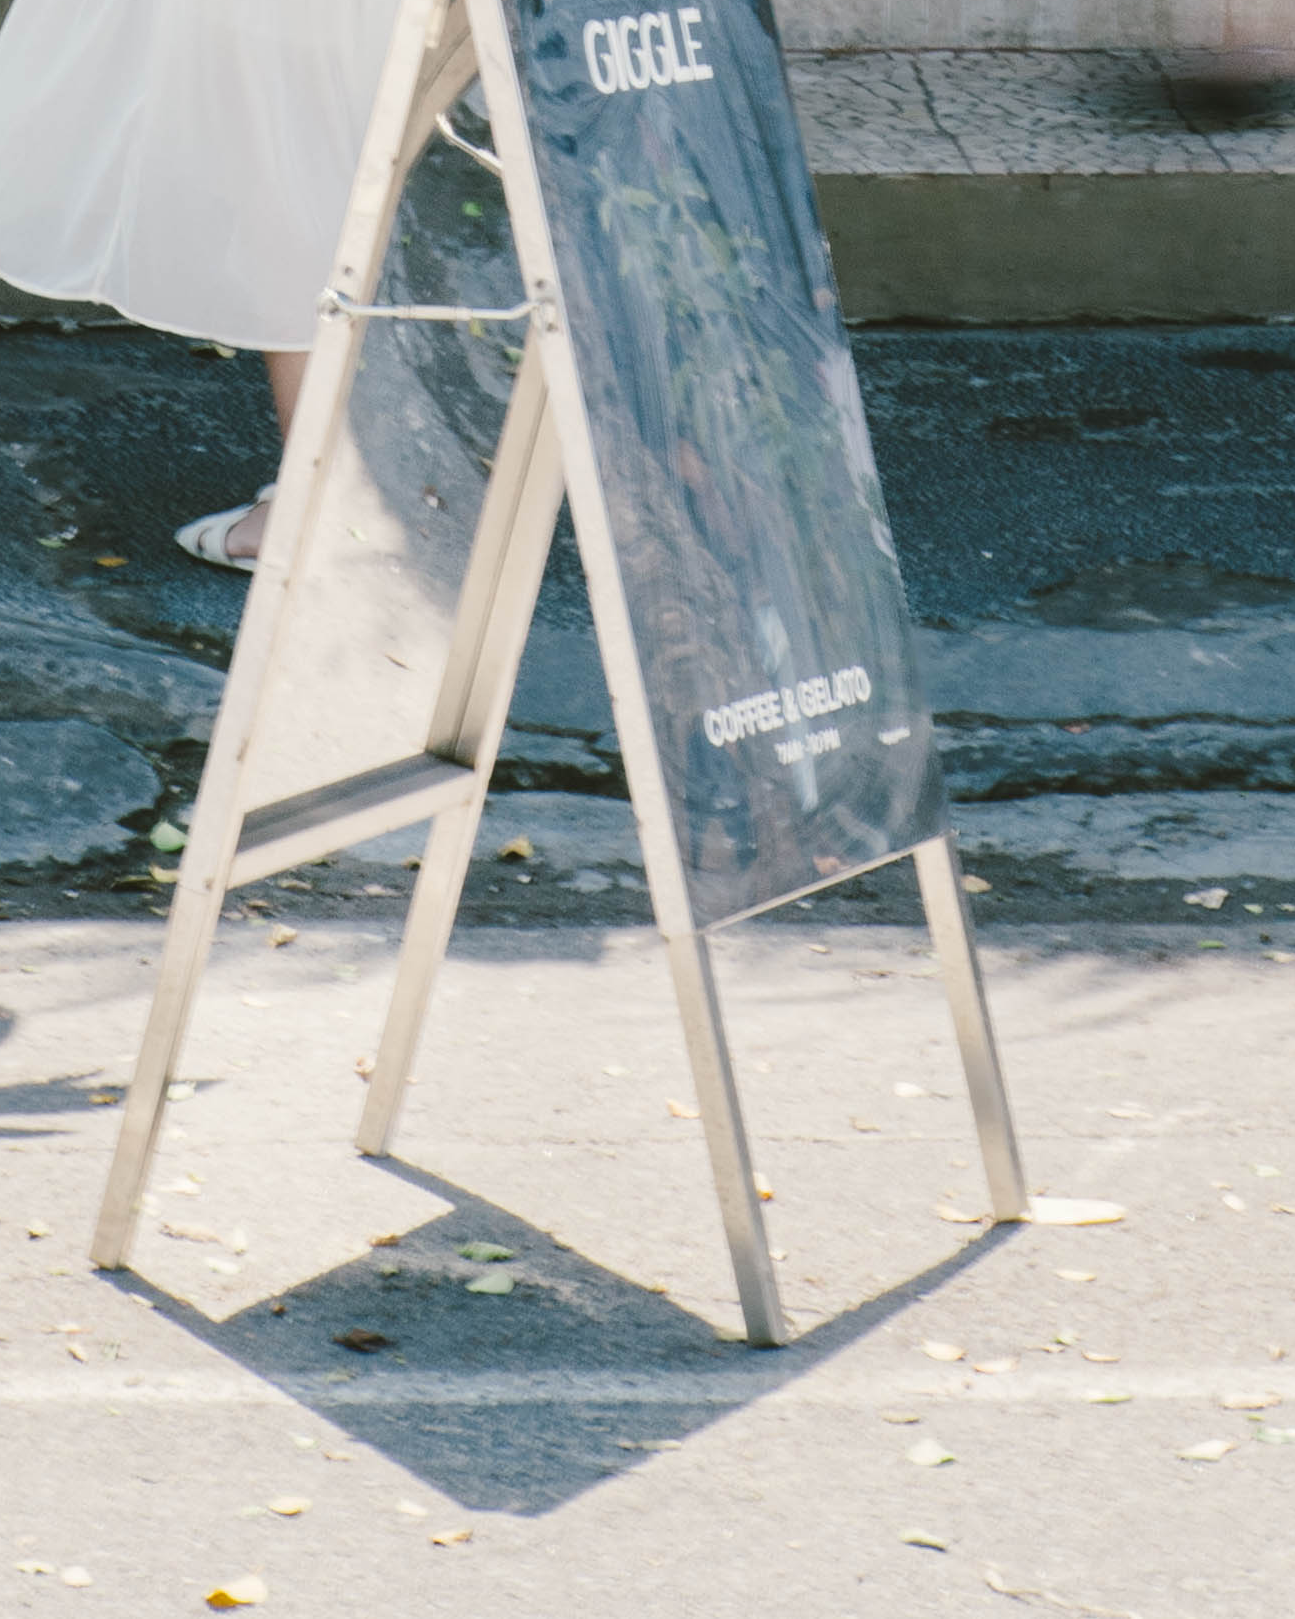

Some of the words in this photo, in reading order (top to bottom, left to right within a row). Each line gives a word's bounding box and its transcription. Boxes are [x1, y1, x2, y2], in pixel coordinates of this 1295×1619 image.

[583, 7, 714, 95] GIGGLE
[703, 691, 785, 748] COFFEE
[780, 687, 801, 724] &
[796, 665, 872, 718] GELATO
